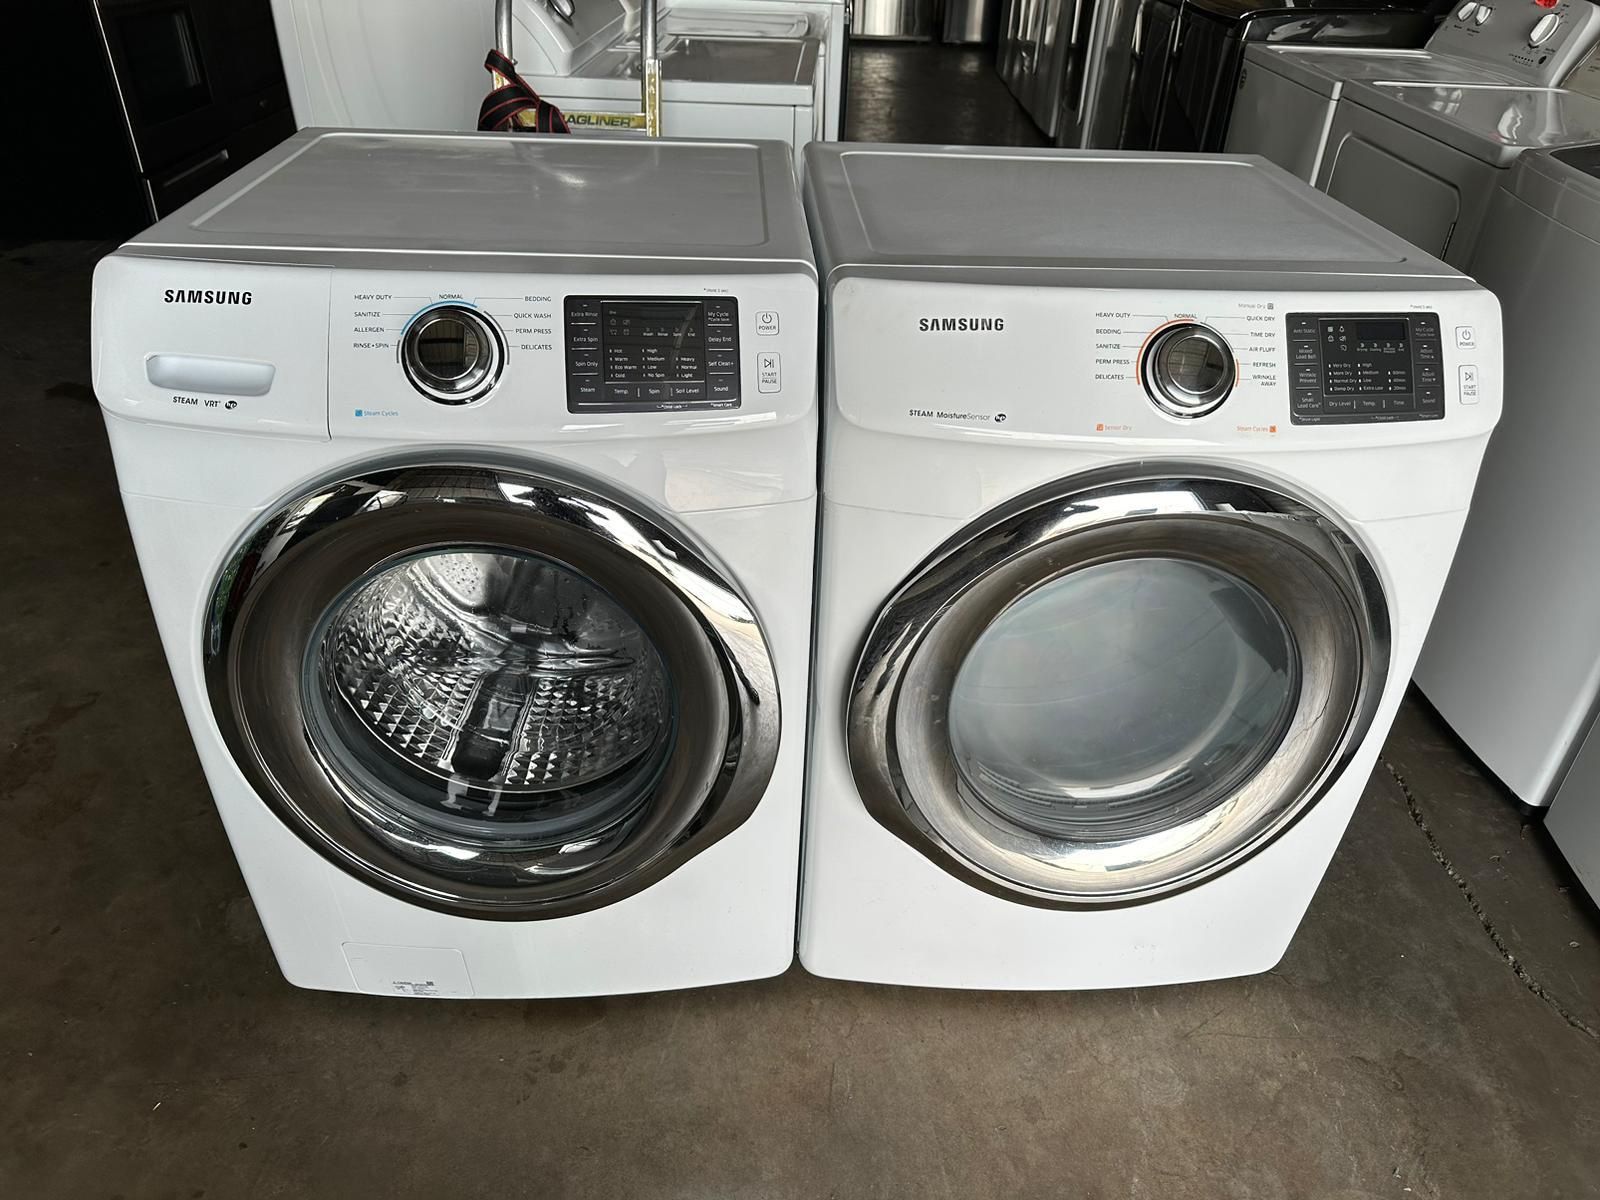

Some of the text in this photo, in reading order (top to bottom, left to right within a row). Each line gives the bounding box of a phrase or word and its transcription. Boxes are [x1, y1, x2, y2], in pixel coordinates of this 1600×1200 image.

[563, 115, 631, 128] AGLINER
[164, 289, 252, 305] SAMSUNG
[919, 318, 1004, 331] SAMSUNG
[172, 396, 198, 405] STEAM
[936, 412, 990, 420] MoistureSensor
